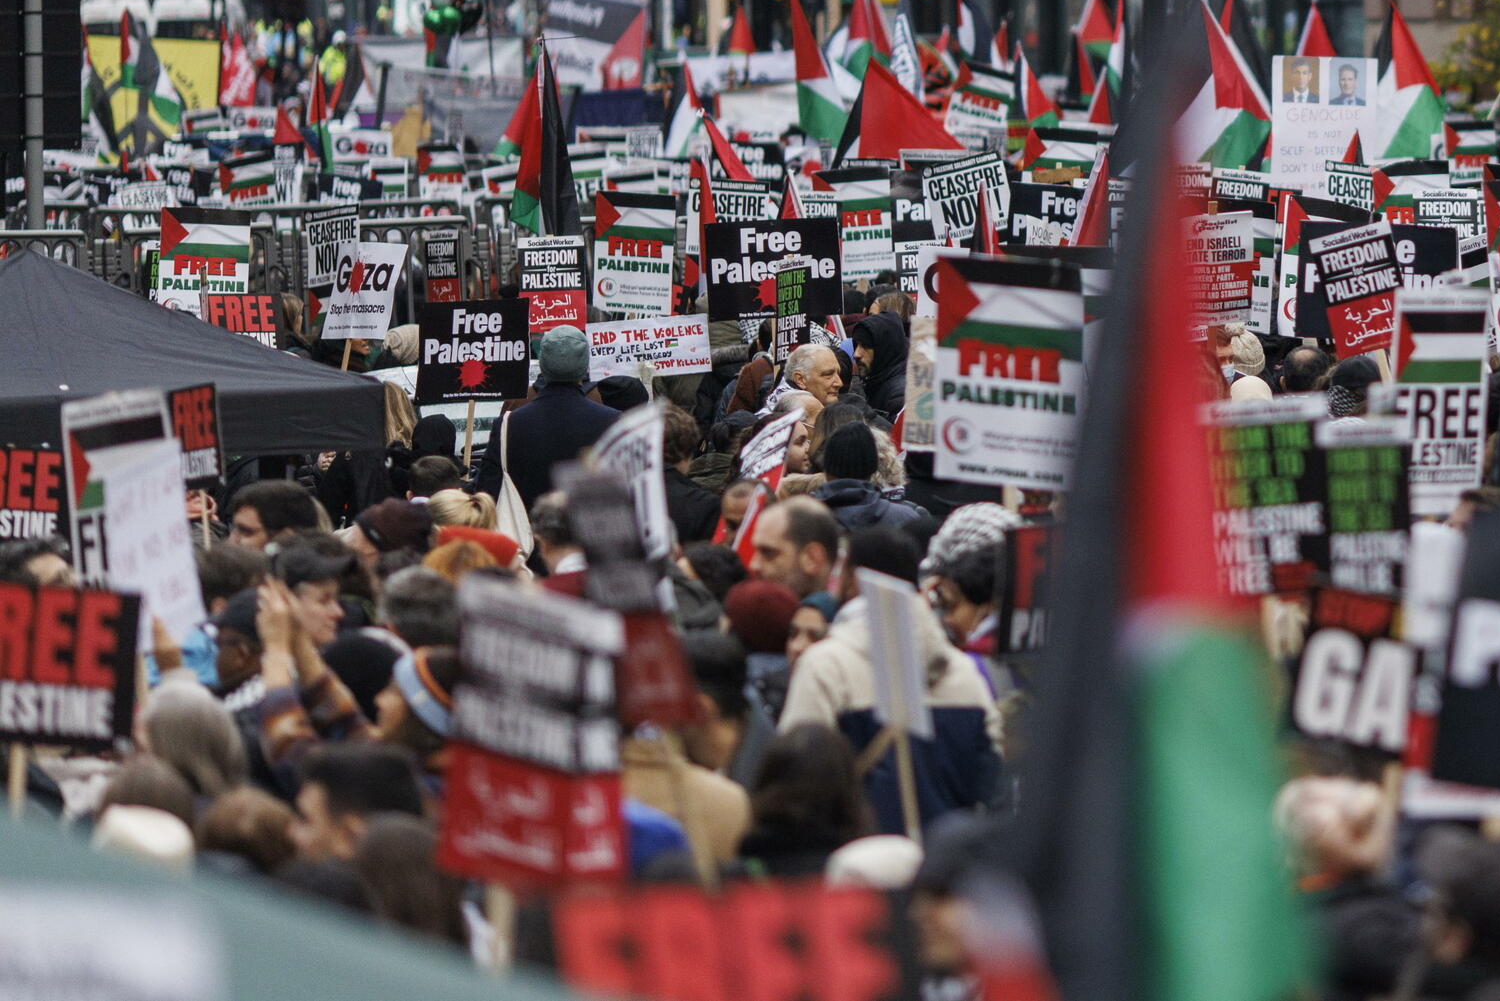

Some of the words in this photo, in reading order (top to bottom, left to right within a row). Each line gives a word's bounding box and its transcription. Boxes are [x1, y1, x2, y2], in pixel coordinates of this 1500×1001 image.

[1315, 145, 1345, 156] DEFEN
[1216, 181, 1263, 199] FREEDOM
[1328, 175, 1374, 197] CEASEFI
[803, 202, 837, 217] EEDOM
[842, 209, 882, 227] REE
[1419, 202, 1471, 216] FREEDOM
[309, 218, 357, 245] CEASEFIRE
[1322, 235, 1351, 248] Socialist
[1350, 228, 1378, 241] Worker
[428, 241, 454, 256] FREEDOM
[607, 236, 663, 258] FREE
[740, 228, 802, 254] Free
[1207, 236, 1240, 249] ISRAELI
[524, 250, 577, 266] FREEDOM
[1186, 249, 1209, 263] TATE
[1212, 249, 1246, 261] TERROR
[1321, 240, 1388, 274] FREEDOM
[174, 255, 237, 276] FREE
[337, 255, 394, 293] Gza
[428, 262, 456, 276] PALESTINE
[547, 265, 556, 274] for
[597, 258, 670, 274] PALESTINE
[162, 278, 245, 292] PALETINE
[522, 272, 581, 289] PALESTINE
[1325, 267, 1399, 303] PALESTINE
[793, 285, 802, 298] TO
[330, 304, 343, 315] Stop
[352, 304, 385, 314] massacre
[533, 294, 571, 310] الحرية
[1344, 299, 1392, 323] الحرية
[209, 296, 276, 332] FREE
[452, 309, 502, 334] Free
[592, 332, 616, 345] END
[622, 329, 649, 342] THE
[424, 337, 525, 364] Palestine
[591, 345, 615, 356] EVERY
[644, 341, 663, 352] LOST
[634, 351, 672, 362] TRAGEDY
[654, 359, 674, 371] STOP
[955, 337, 1062, 385] FREE
[941, 380, 1077, 415] PALESTINE
[0, 509, 57, 538] STINE
[0, 584, 122, 693] REE
[1293, 627, 1416, 751] GA
